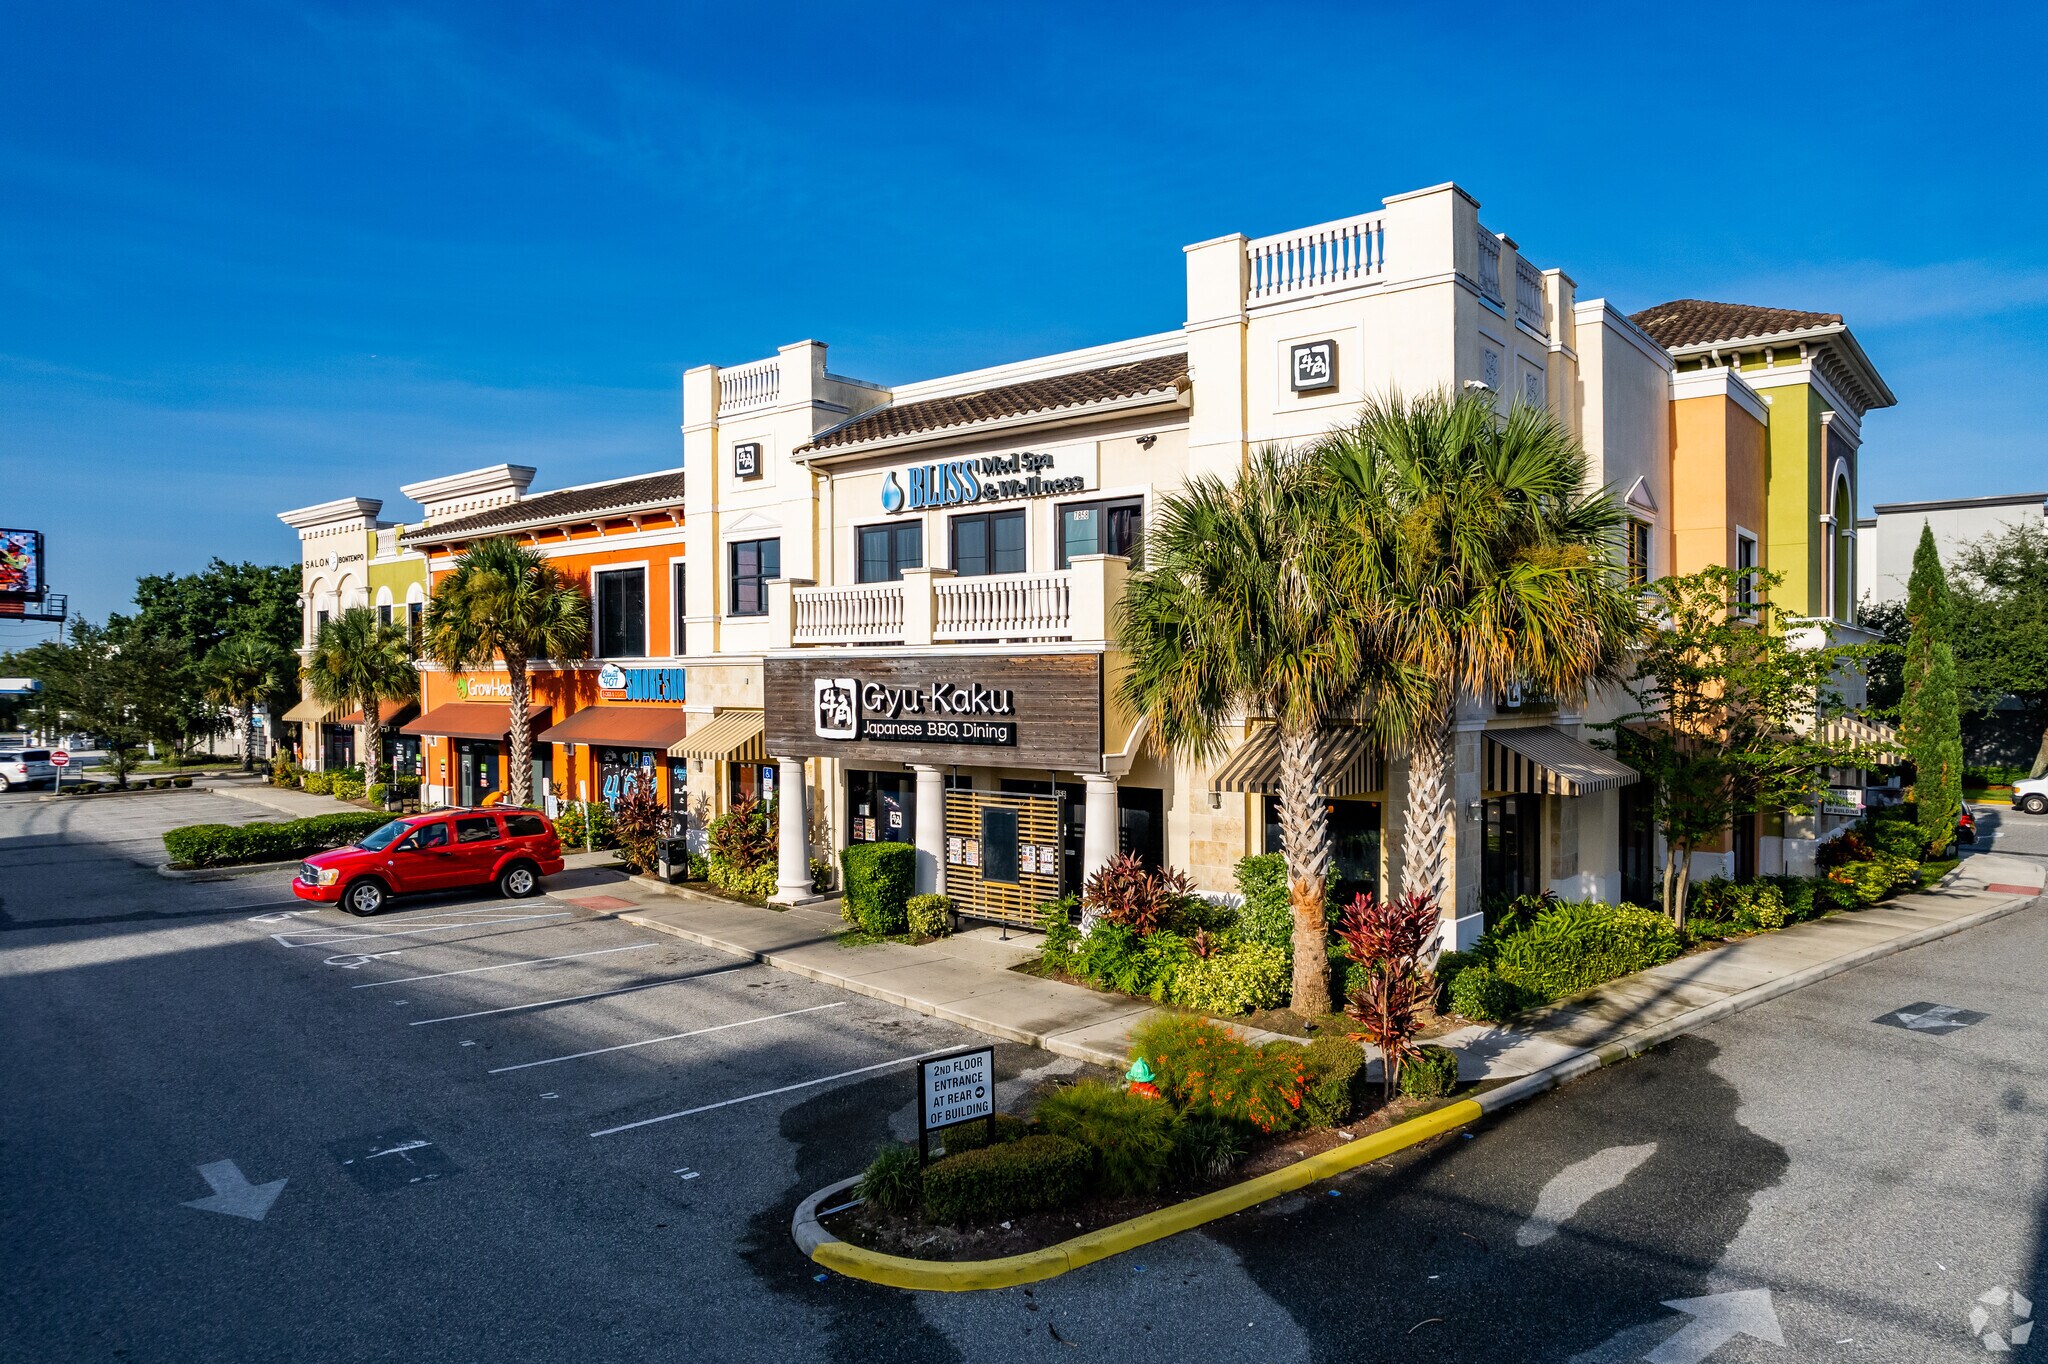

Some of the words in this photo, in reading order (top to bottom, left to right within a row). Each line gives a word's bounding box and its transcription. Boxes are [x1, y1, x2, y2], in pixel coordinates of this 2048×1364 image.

[907, 459, 980, 508] BLISS
[981, 453, 1020, 475] Med
[1021, 451, 1054, 475] Spa
[982, 484, 999, 500] &
[999, 475, 1085, 498] Wellness
[305, 558, 329, 569] SALON
[338, 553, 364, 564] BONTEMPO
[603, 677, 619, 687] 407
[862, 682, 1011, 718] Gyu-Kaku
[863, 720, 923, 738] Japanese
[927, 722, 959, 738] BBQ
[963, 723, 1008, 742] Dining
[934, 1065, 950, 1076] 2ND
[954, 1057, 982, 1072] FLOOR
[935, 1072, 983, 1091] ENTRANCE
[934, 1096, 944, 1108] AT
[948, 1090, 972, 1104] REAR
[931, 1112, 942, 1124] OF
[946, 1101, 988, 1120] BUILDING
